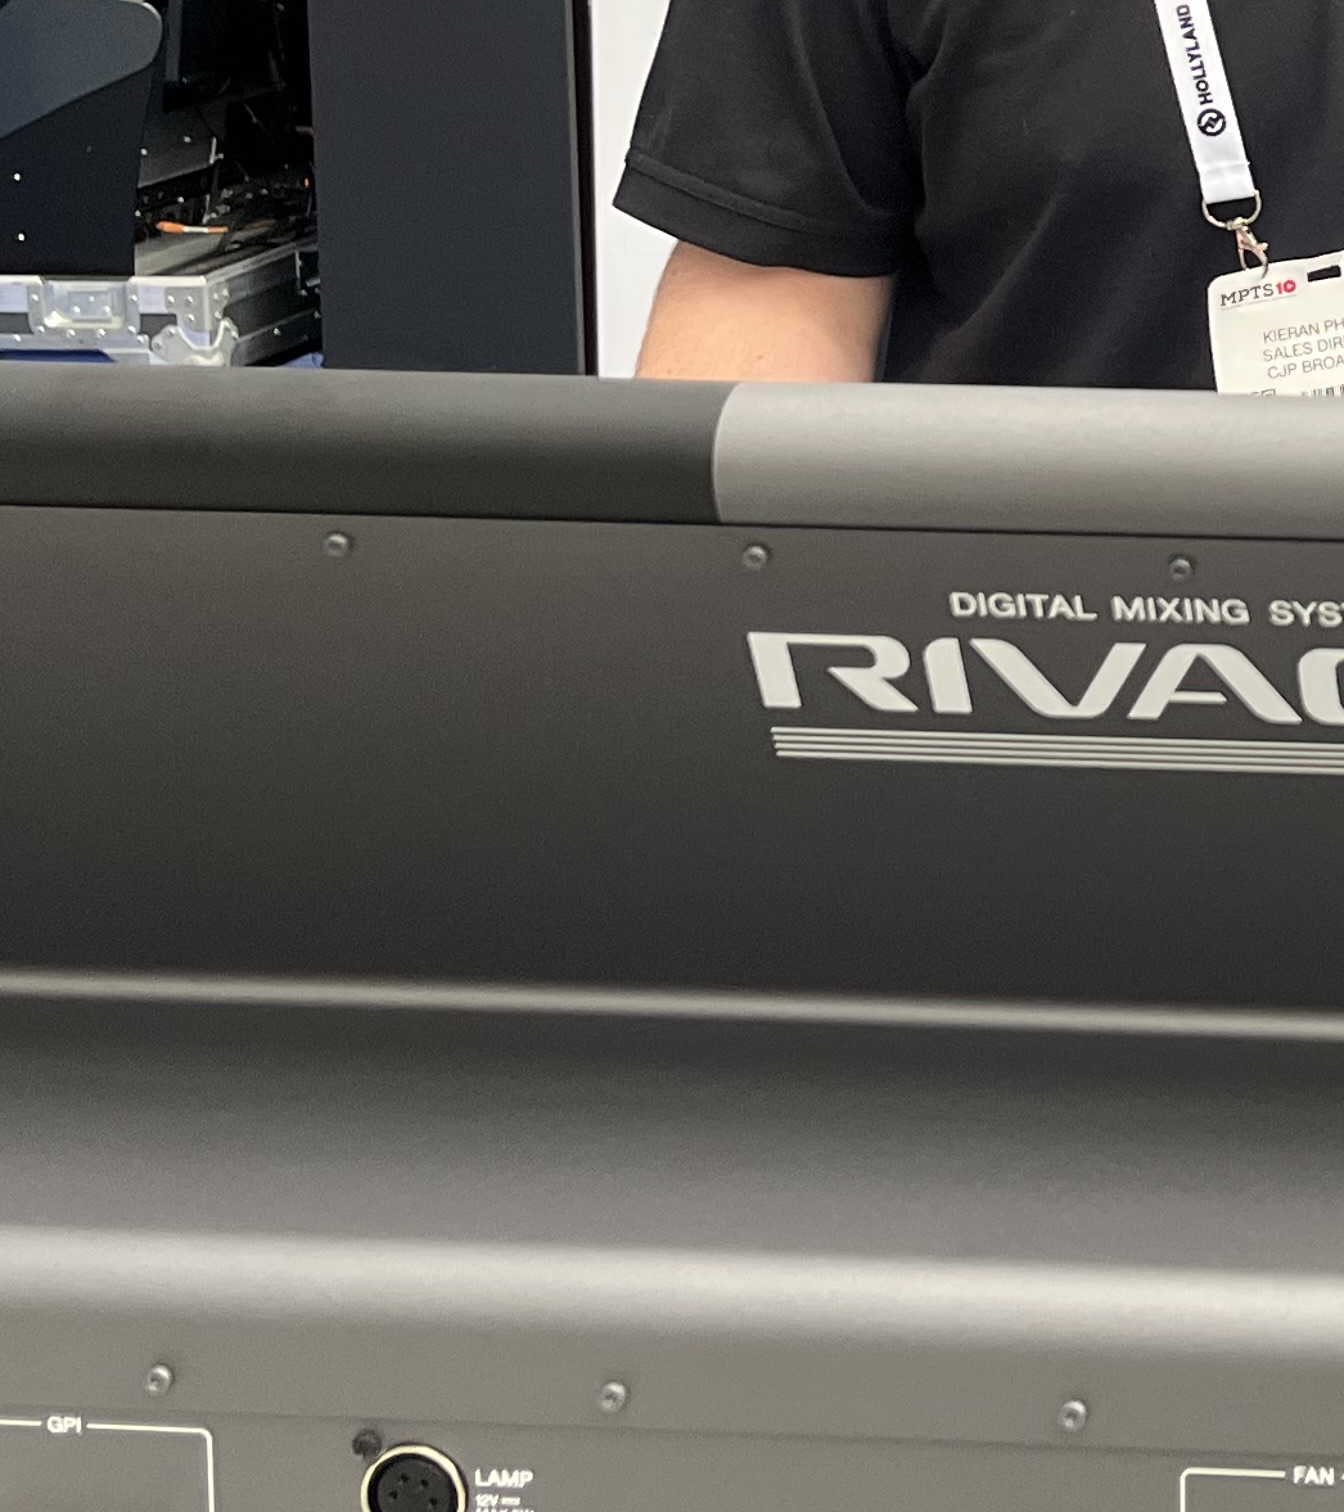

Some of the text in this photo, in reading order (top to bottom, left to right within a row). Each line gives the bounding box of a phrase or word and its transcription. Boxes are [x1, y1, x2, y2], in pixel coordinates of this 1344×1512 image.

[1176, 3, 1214, 105] HOLLYLAND
[1263, 324, 1321, 343] KIERAN
[1263, 342, 1313, 363] SALES
[1267, 361, 1297, 380] CJP
[949, 591, 1098, 621] DIGITAL
[1112, 595, 1250, 625] MIXING
[46, 1415, 83, 1434] GPI
[475, 1468, 534, 1488] LAMP
[1293, 1465, 1335, 1486] FAN
